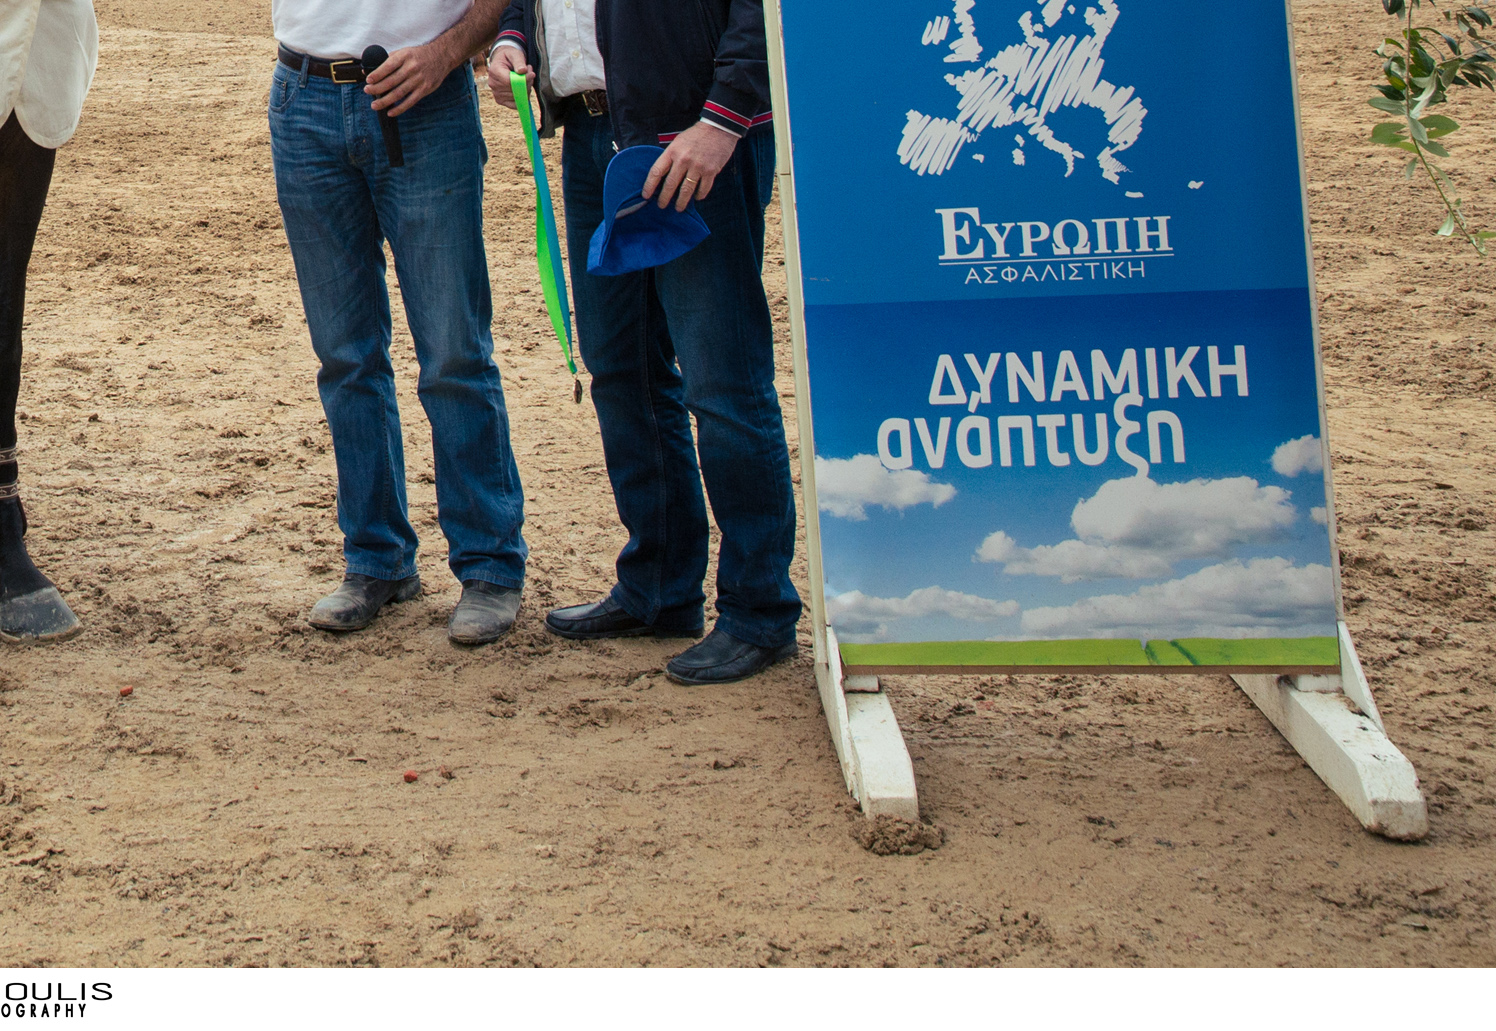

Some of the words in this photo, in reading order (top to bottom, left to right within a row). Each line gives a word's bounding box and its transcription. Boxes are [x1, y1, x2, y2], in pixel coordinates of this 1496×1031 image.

[964, 260, 1146, 285] ΑΣΦΑΛΙΣΤΙΚΗ
[928, 345, 1249, 405] ΔΥΝΑΜΙΚΗ
[877, 391, 1186, 479] ανάπτυξη
